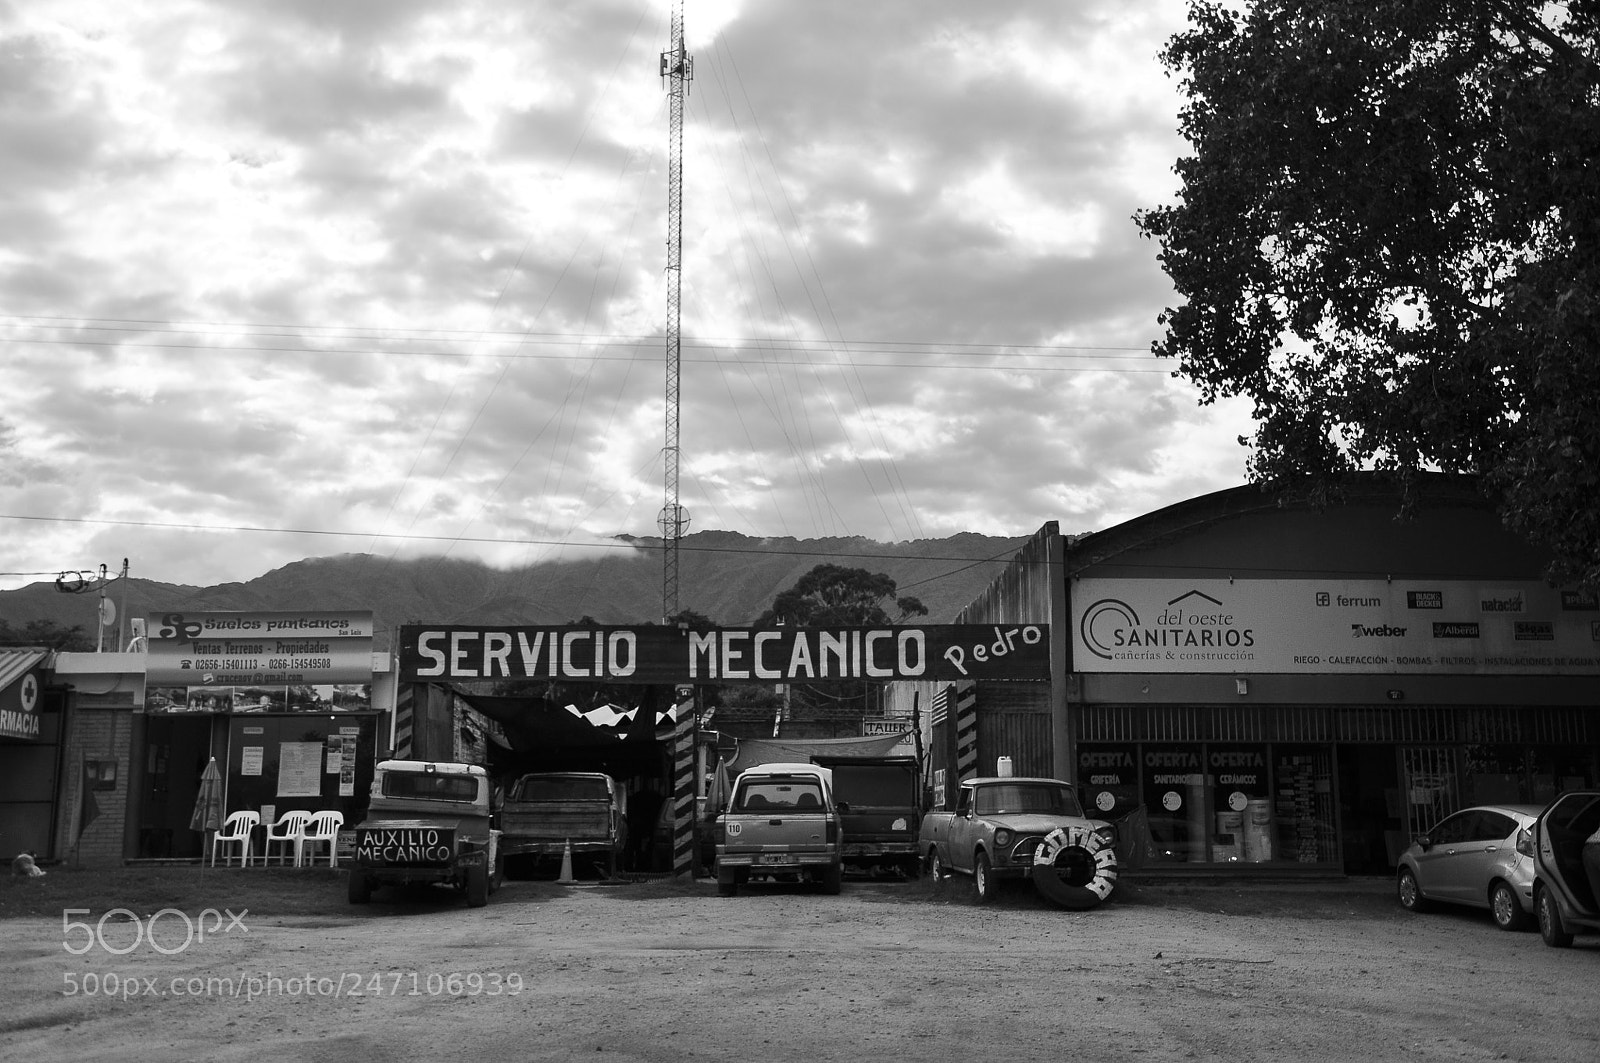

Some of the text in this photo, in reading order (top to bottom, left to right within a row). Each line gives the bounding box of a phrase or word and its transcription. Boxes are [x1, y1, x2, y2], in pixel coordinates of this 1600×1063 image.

[1337, 595, 1381, 607] ferrum
[205, 617, 349, 633] Suelos puntanos
[1157, 609, 1233, 626] del oeste
[1113, 628, 1255, 647] SANITARIOS
[1362, 624, 1408, 637] weber
[1444, 625, 1479, 636] Alberdi
[193, 641, 222, 655] Ventas
[225, 641, 263, 655] Terrenos
[276, 641, 330, 656] Propiedades
[417, 629, 926, 679] SERVICIO MECANICO
[943, 626, 1042, 675] Pedro
[1114, 649, 1255, 661] cañerías & construcción
[195, 658, 259, 670] 02656-15401113
[268, 657, 332, 670] 0266-154549508
[1293, 656, 1320, 664] RIEGO
[1328, 654, 1388, 664] CALEFACCIÓN
[1397, 656, 1432, 665] BOMBAS
[1440, 656, 1477, 666] FILTROS
[1484, 656, 1553, 667] INSTALACIONES
[1554, 656, 1567, 667] DE
[0, 709, 40, 735] RMACIA
[866, 722, 907, 733] TALLER
[1081, 752, 1134, 767] OFERTA
[1145, 752, 1199, 767] OFERTA
[1210, 752, 1264, 767] OFERTA
[1090, 773, 1121, 785] GRIFERÍA
[1219, 773, 1257, 785] CERÁMICOS
[728, 824, 740, 833] 110
[363, 829, 439, 846] AUXILIO
[357, 846, 450, 862] MECANICO
[1034, 827, 1117, 901] GOMERIA
